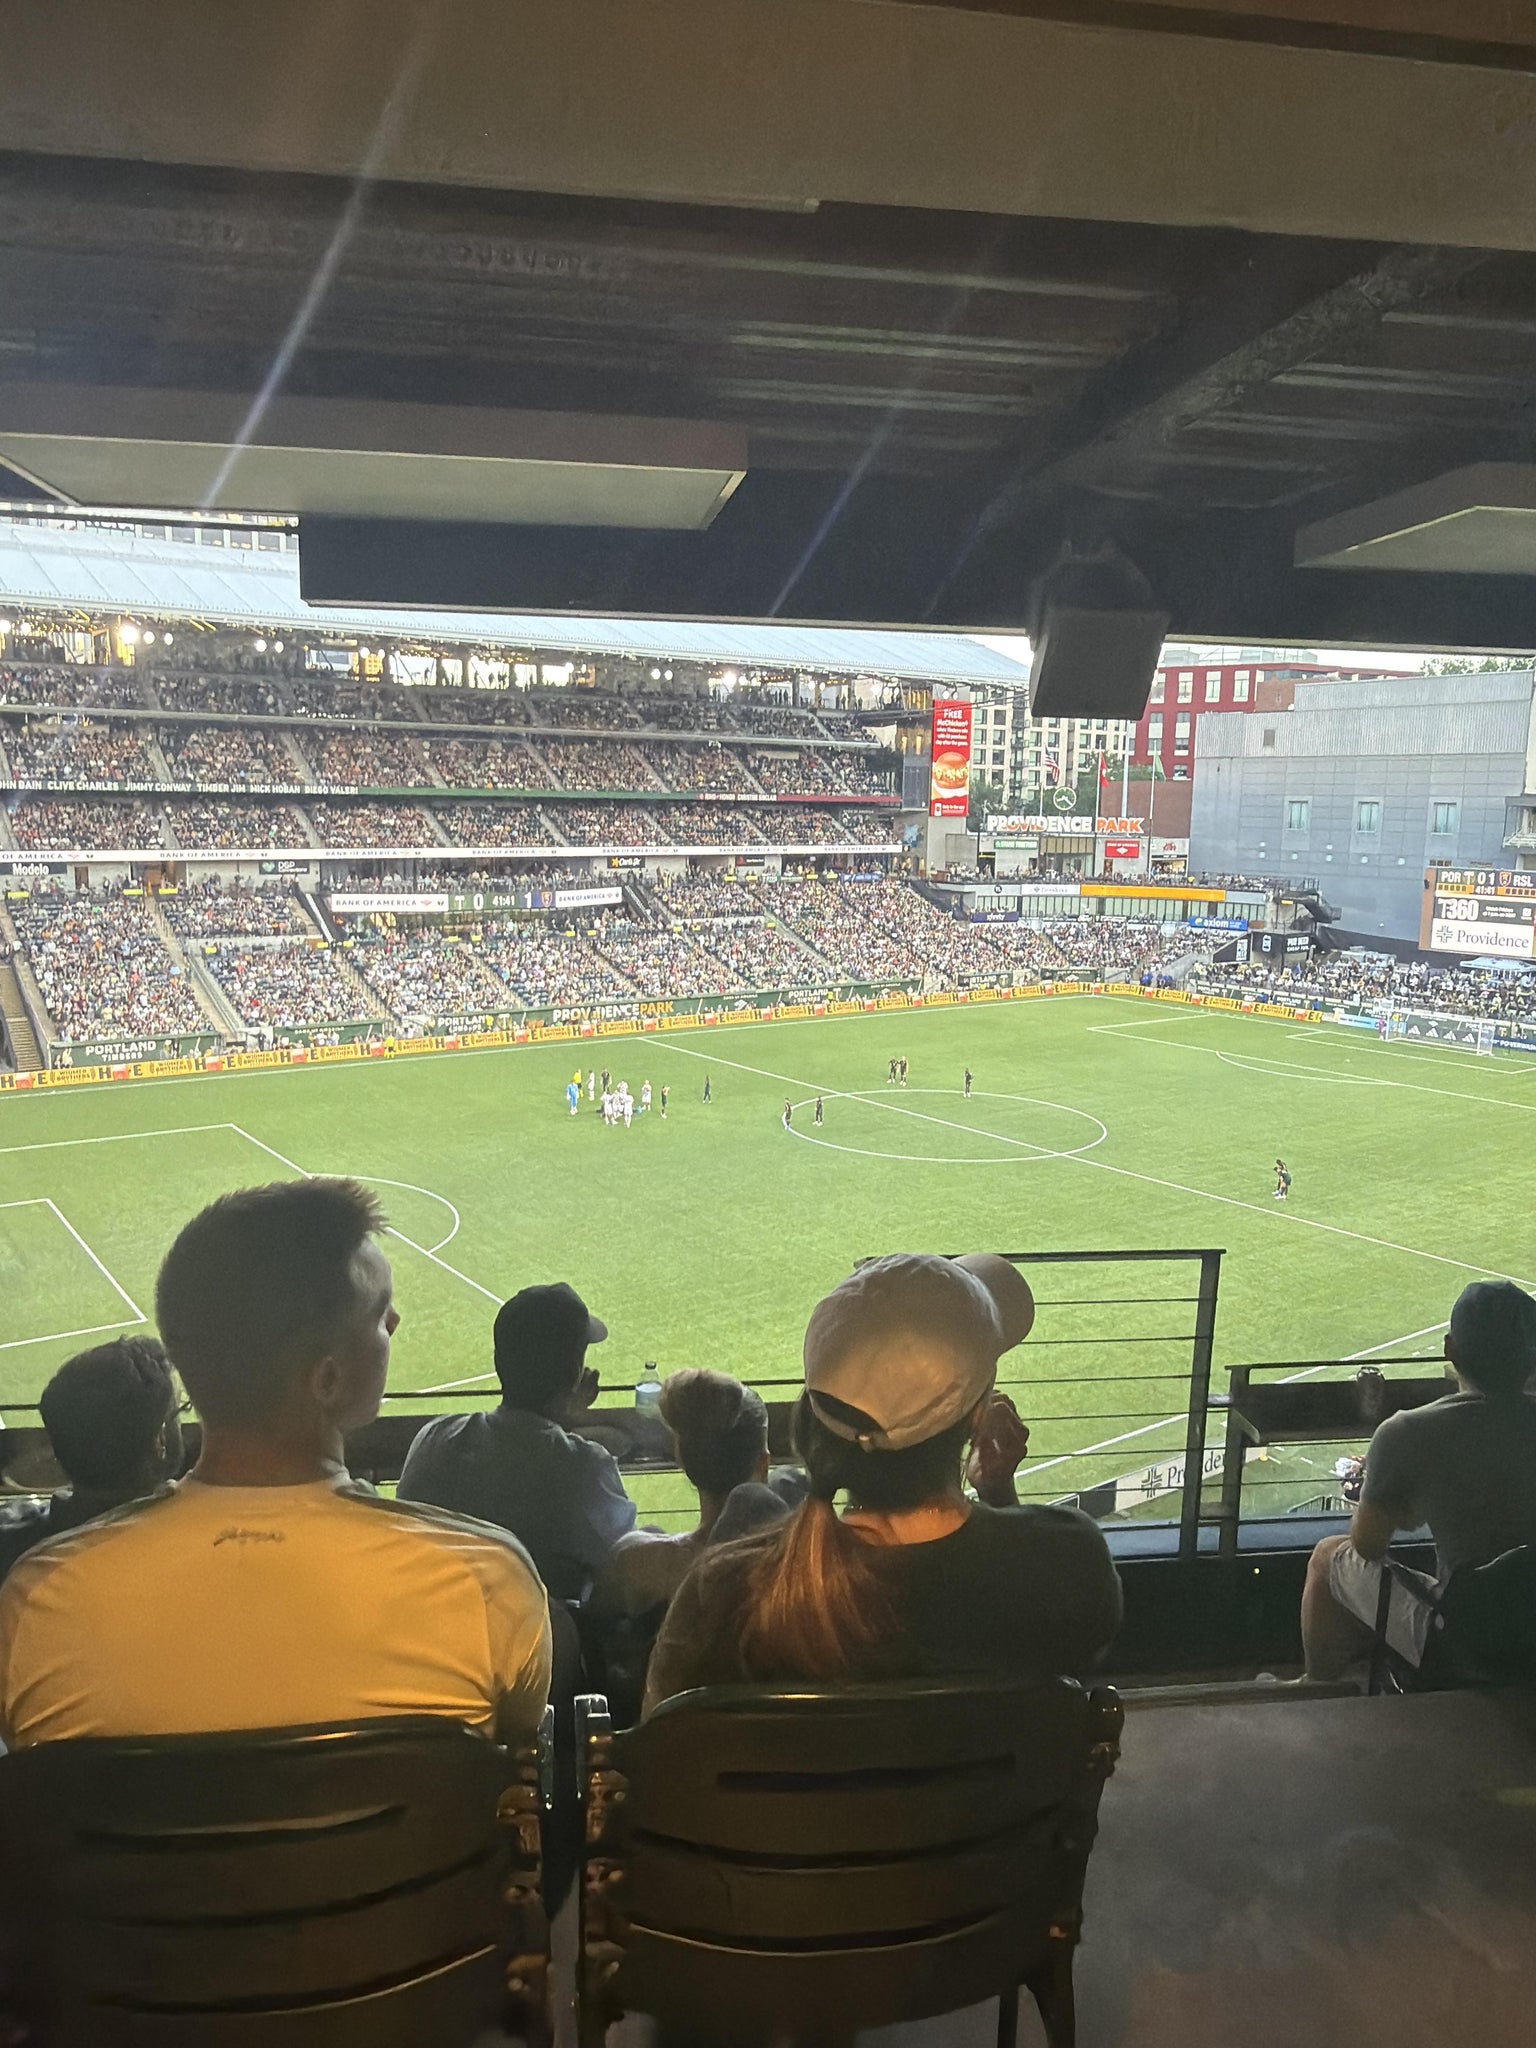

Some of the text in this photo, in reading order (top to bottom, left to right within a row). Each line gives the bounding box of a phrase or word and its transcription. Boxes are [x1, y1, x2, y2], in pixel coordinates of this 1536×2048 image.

[944, 709, 962, 718] FREE
[18, 780, 42, 790] DAIN
[47, 780, 119, 791] CLIVE CHARLES
[124, 782, 192, 792] JIMMY CONWAY
[196, 784, 246, 792] TIMBER JIM
[250, 784, 270, 793] MICK
[304, 786, 358, 794] DIEGO VALERI
[987, 815, 1144, 834] PROVIDENCE PARK
[12, 863, 49, 876] Modelo
[1441, 871, 1461, 882] POR
[1478, 872, 1486, 884] 0
[1488, 872, 1495, 885] 1
[1513, 875, 1534, 887] RSL
[1475, 886, 1495, 895] 41:41
[473, 893, 484, 910] 0
[492, 895, 515, 906] 41:41
[524, 892, 532, 908] 1
[1203, 918, 1228, 927] axiom
[1457, 930, 1529, 948] Providence
[640, 1001, 674, 1014] PARK
[438, 1015, 489, 1028] PORTLAN
[86, 1040, 156, 1056] PORTLAND
[102, 1052, 142, 1062] TIMBERS
